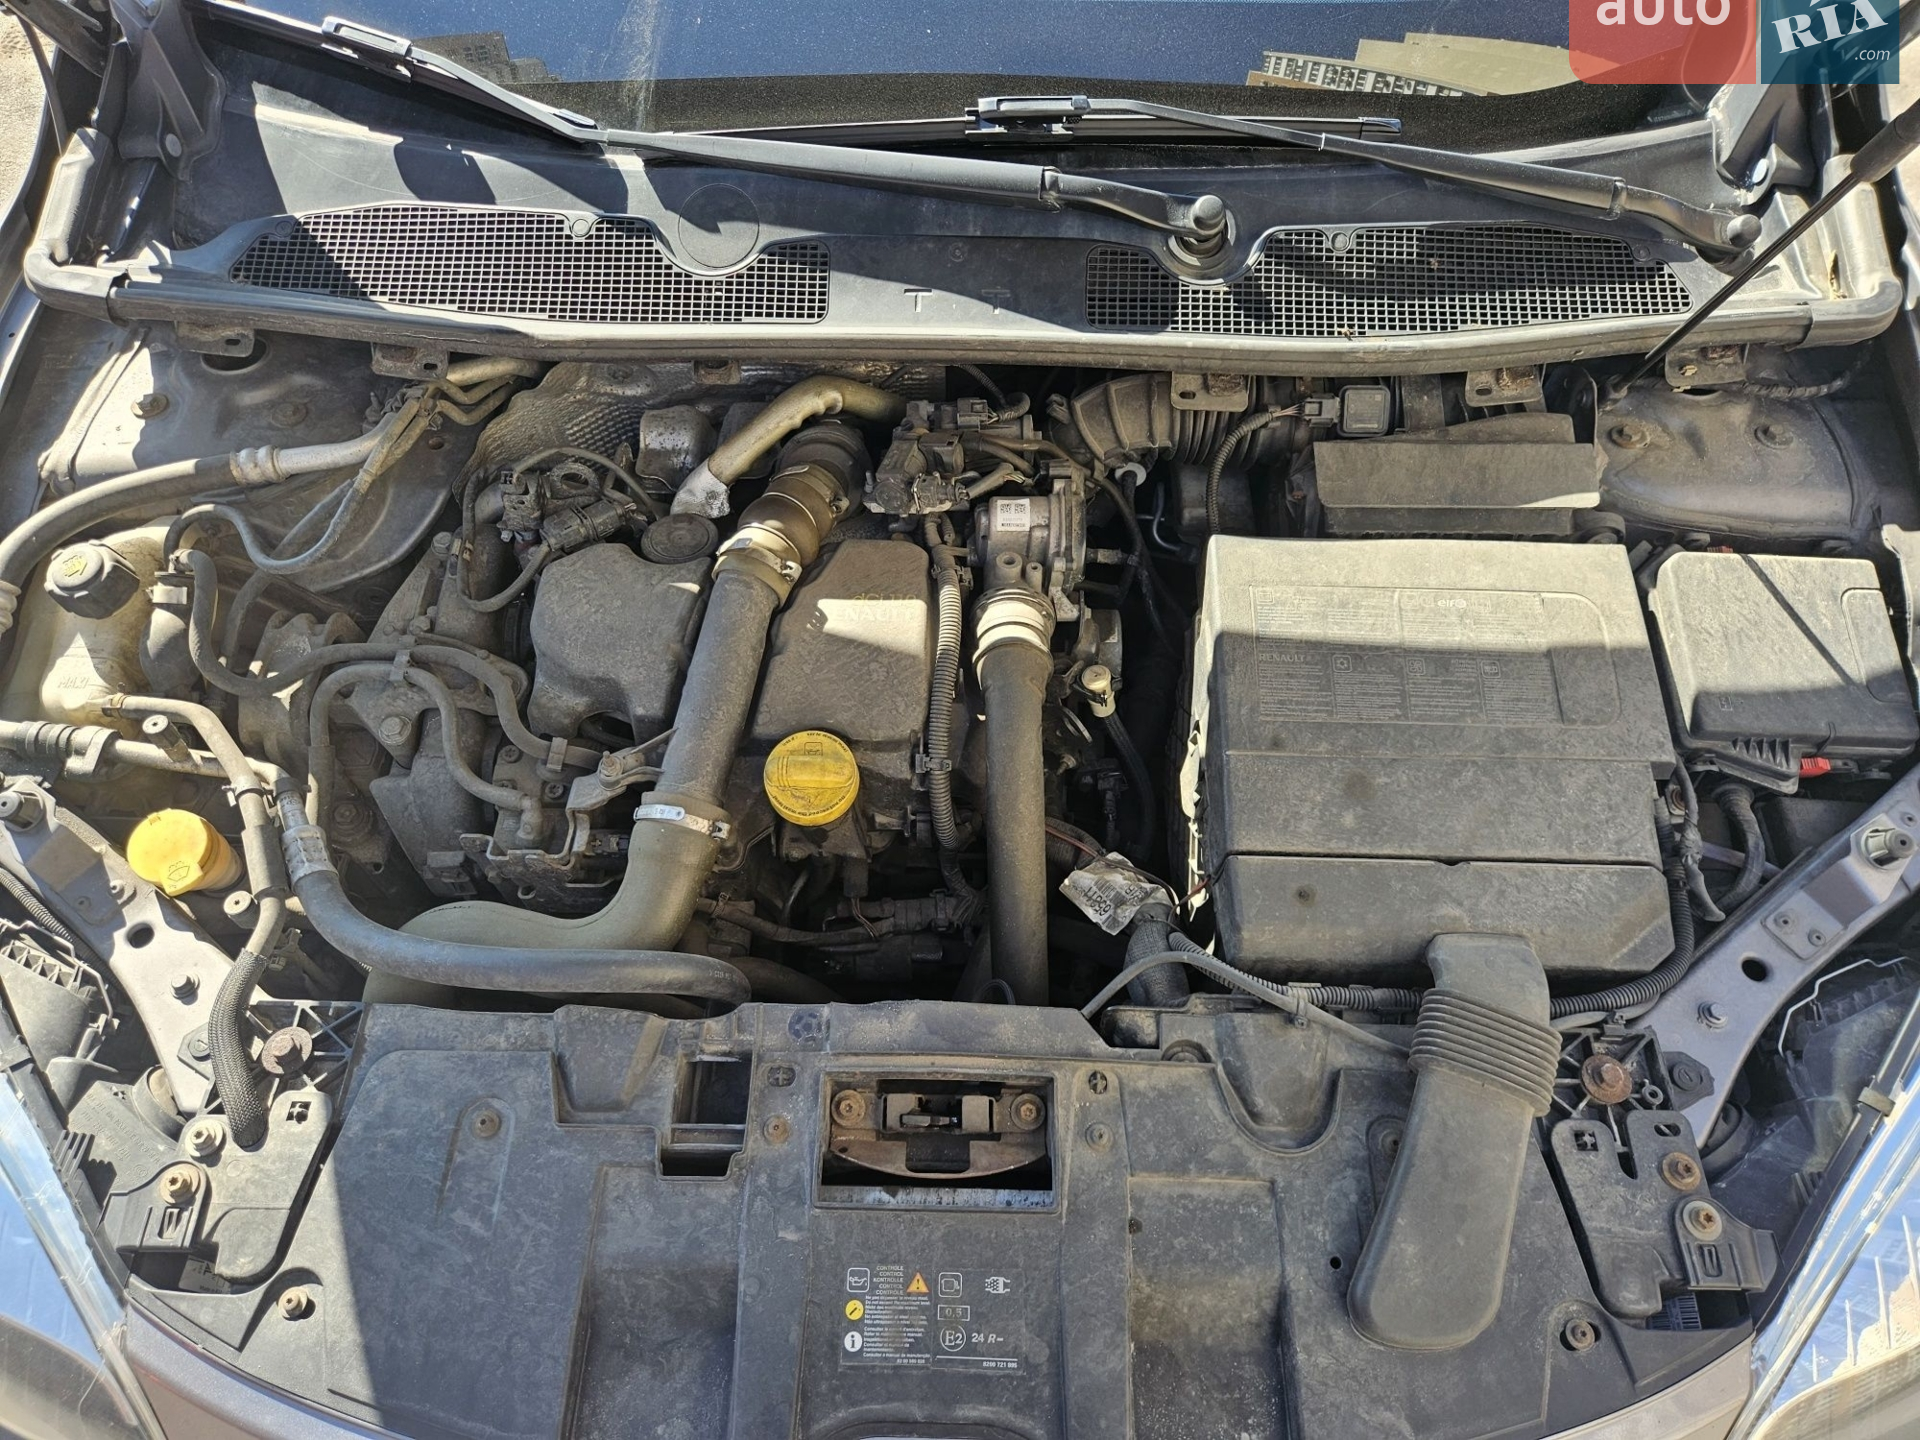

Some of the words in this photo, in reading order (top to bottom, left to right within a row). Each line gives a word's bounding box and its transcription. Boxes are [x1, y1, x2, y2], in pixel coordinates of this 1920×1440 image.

[1258, 653, 1306, 663] RENAULT
[944, 1329, 963, 1346] E2
[971, 1333, 985, 1343] 24
